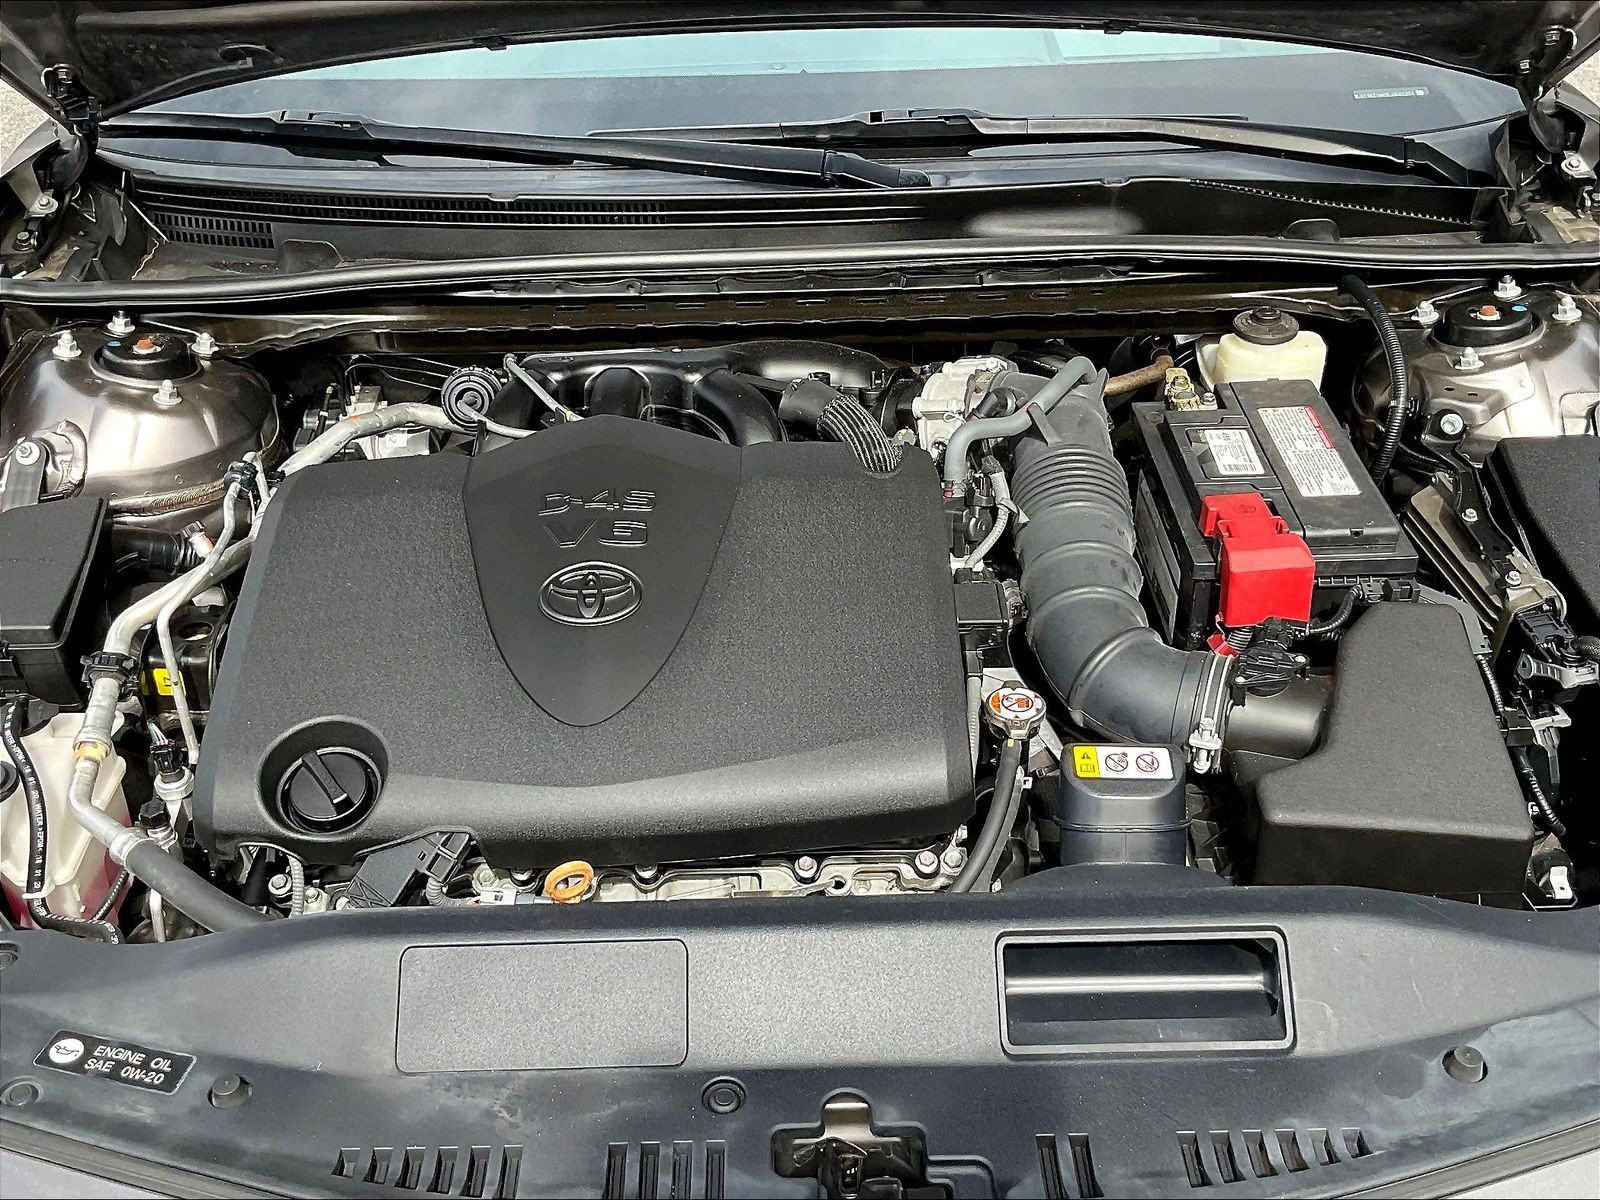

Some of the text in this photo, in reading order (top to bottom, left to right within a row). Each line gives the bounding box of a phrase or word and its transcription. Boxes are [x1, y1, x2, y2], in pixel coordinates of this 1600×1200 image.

[538, 489, 656, 516] D-4S
[543, 518, 648, 547] V6
[31, 789, 40, 799] 20
[35, 802, 44, 827] WATER
[93, 1045, 172, 1071] ENGINE OIL
[84, 1058, 165, 1085] SAE 0W-20
